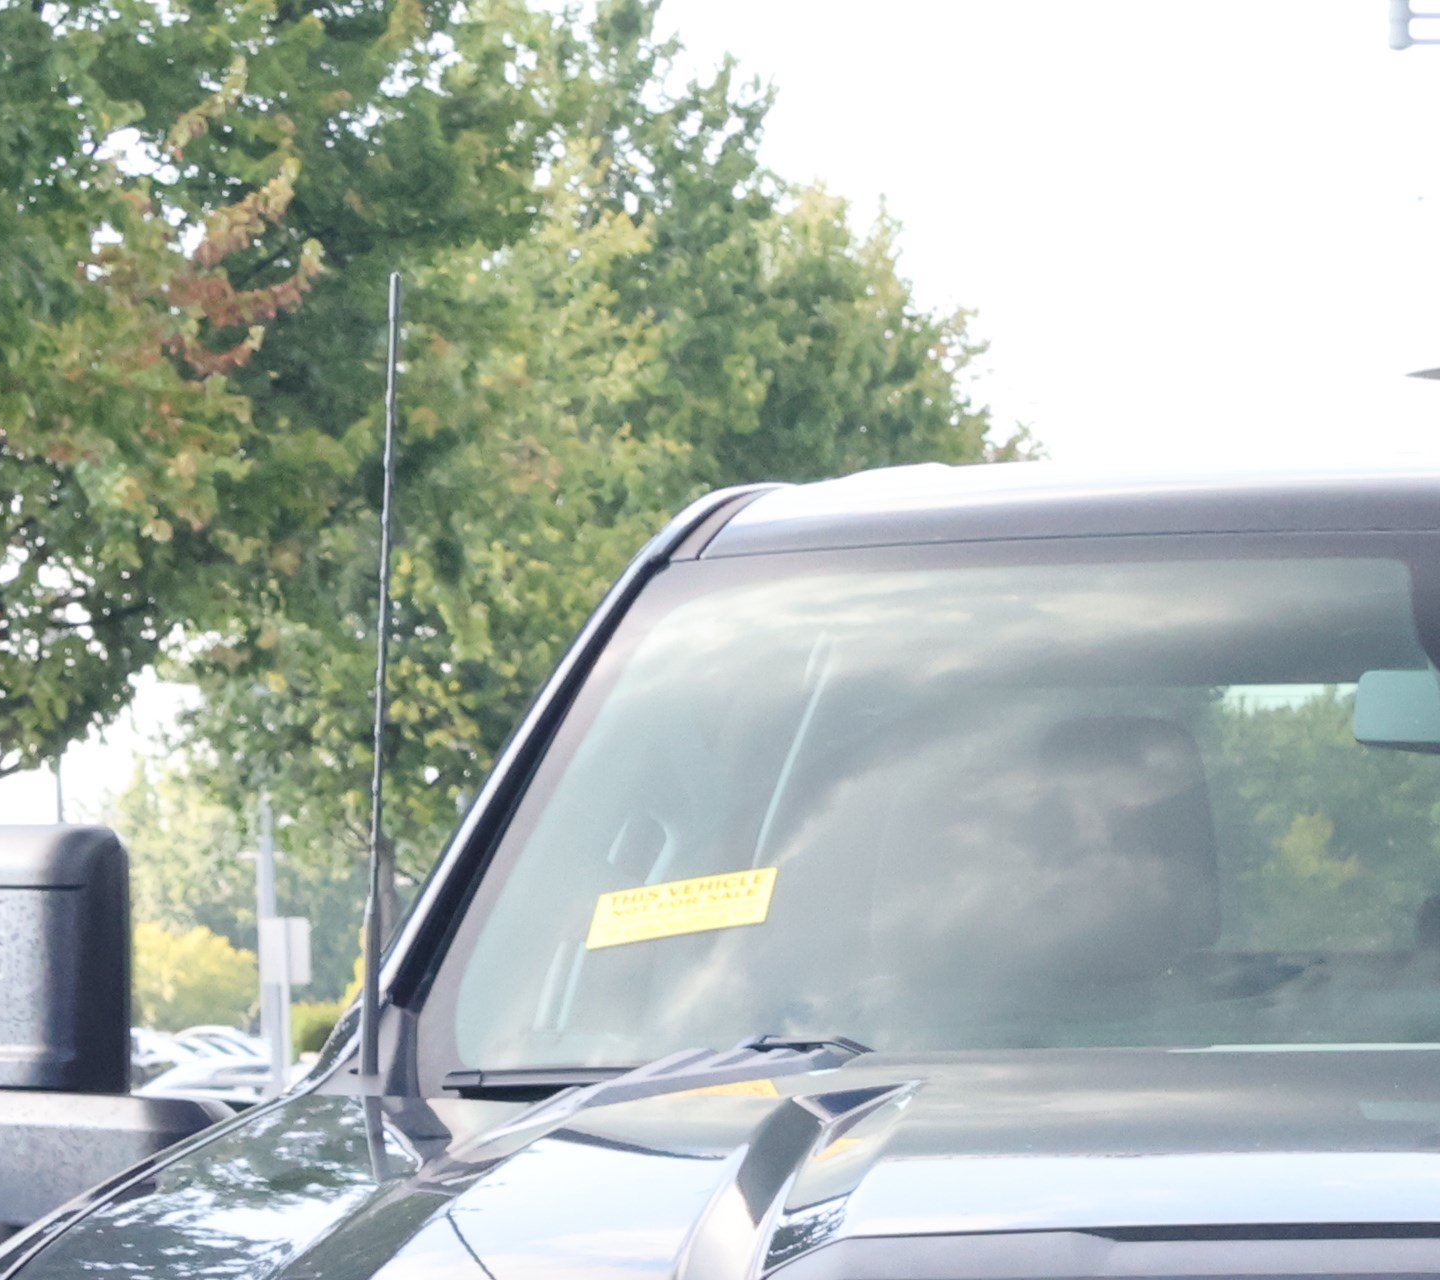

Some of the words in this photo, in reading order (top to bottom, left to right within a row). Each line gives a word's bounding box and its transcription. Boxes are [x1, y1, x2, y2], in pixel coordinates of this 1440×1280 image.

[611, 890, 659, 906] THIS
[669, 873, 763, 896] VEHICLE
[707, 887, 757, 901] SALE
